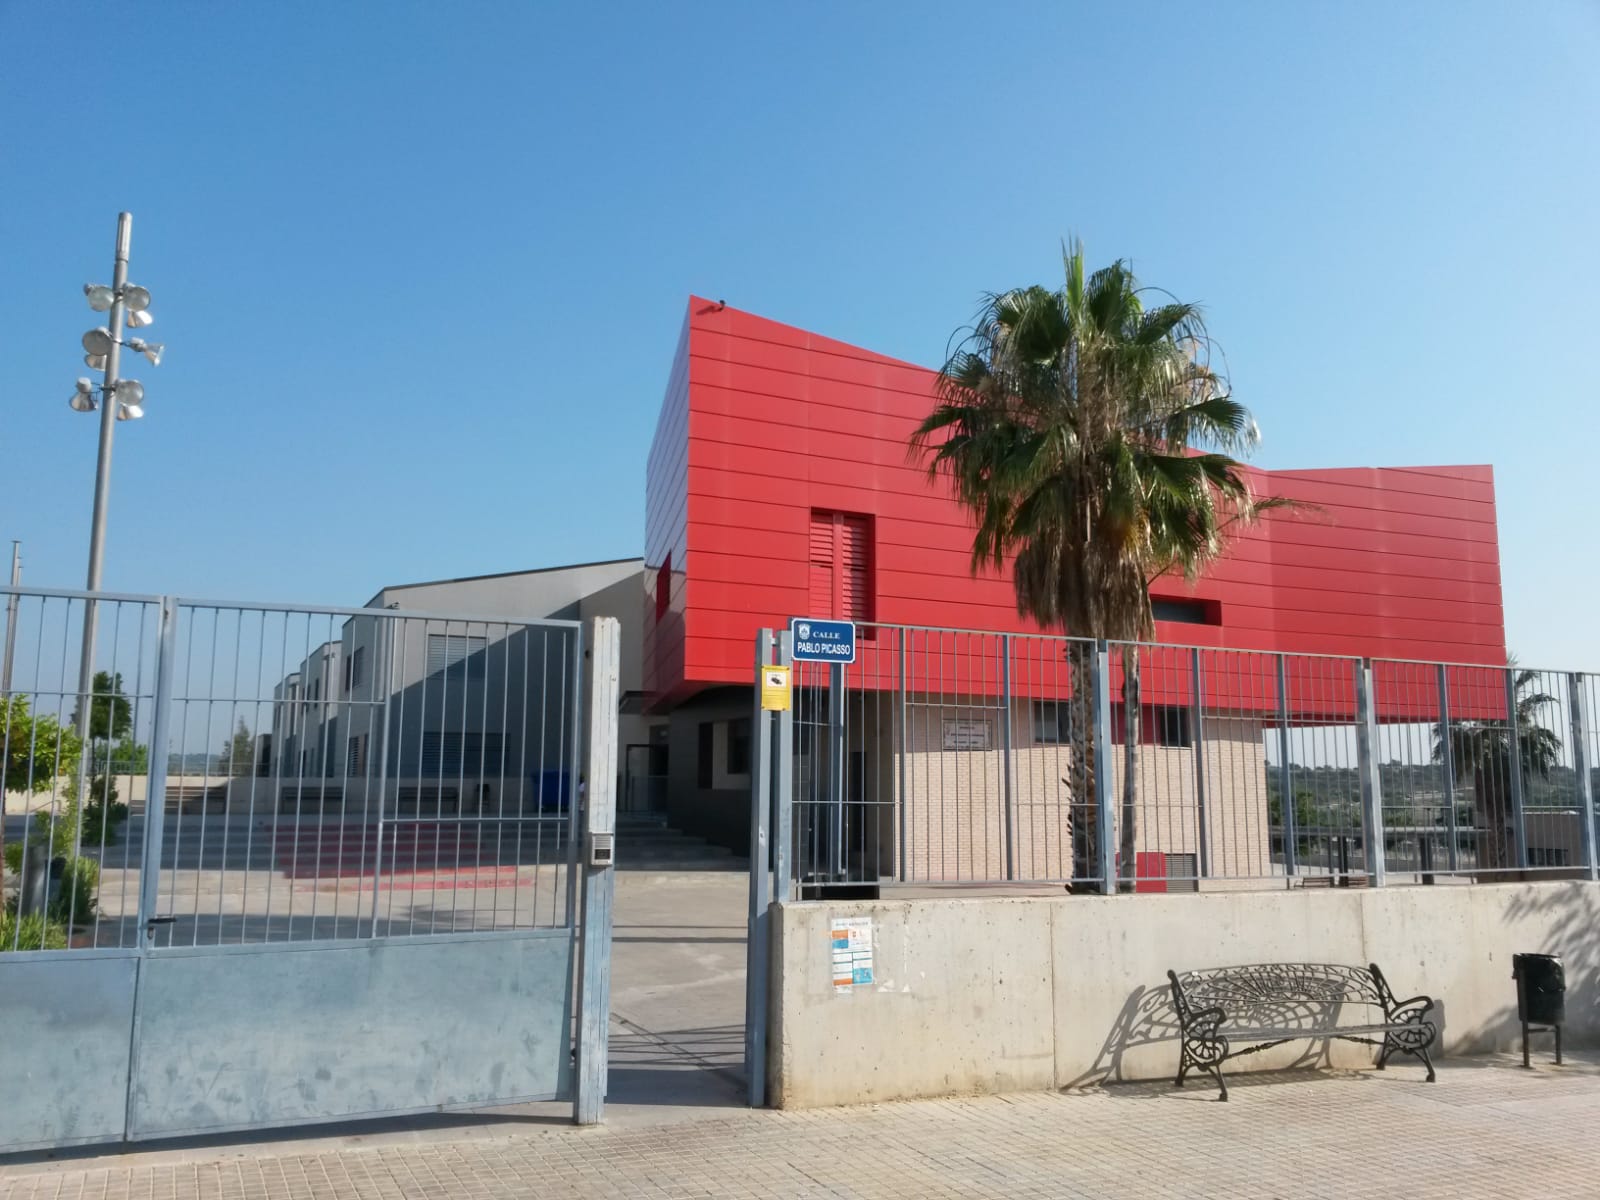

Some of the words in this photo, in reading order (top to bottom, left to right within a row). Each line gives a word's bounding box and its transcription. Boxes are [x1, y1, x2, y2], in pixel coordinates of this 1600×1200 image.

[813, 631, 840, 639] CALLE
[797, 642, 820, 653] PABLO
[821, 643, 850, 655] PICASSO
